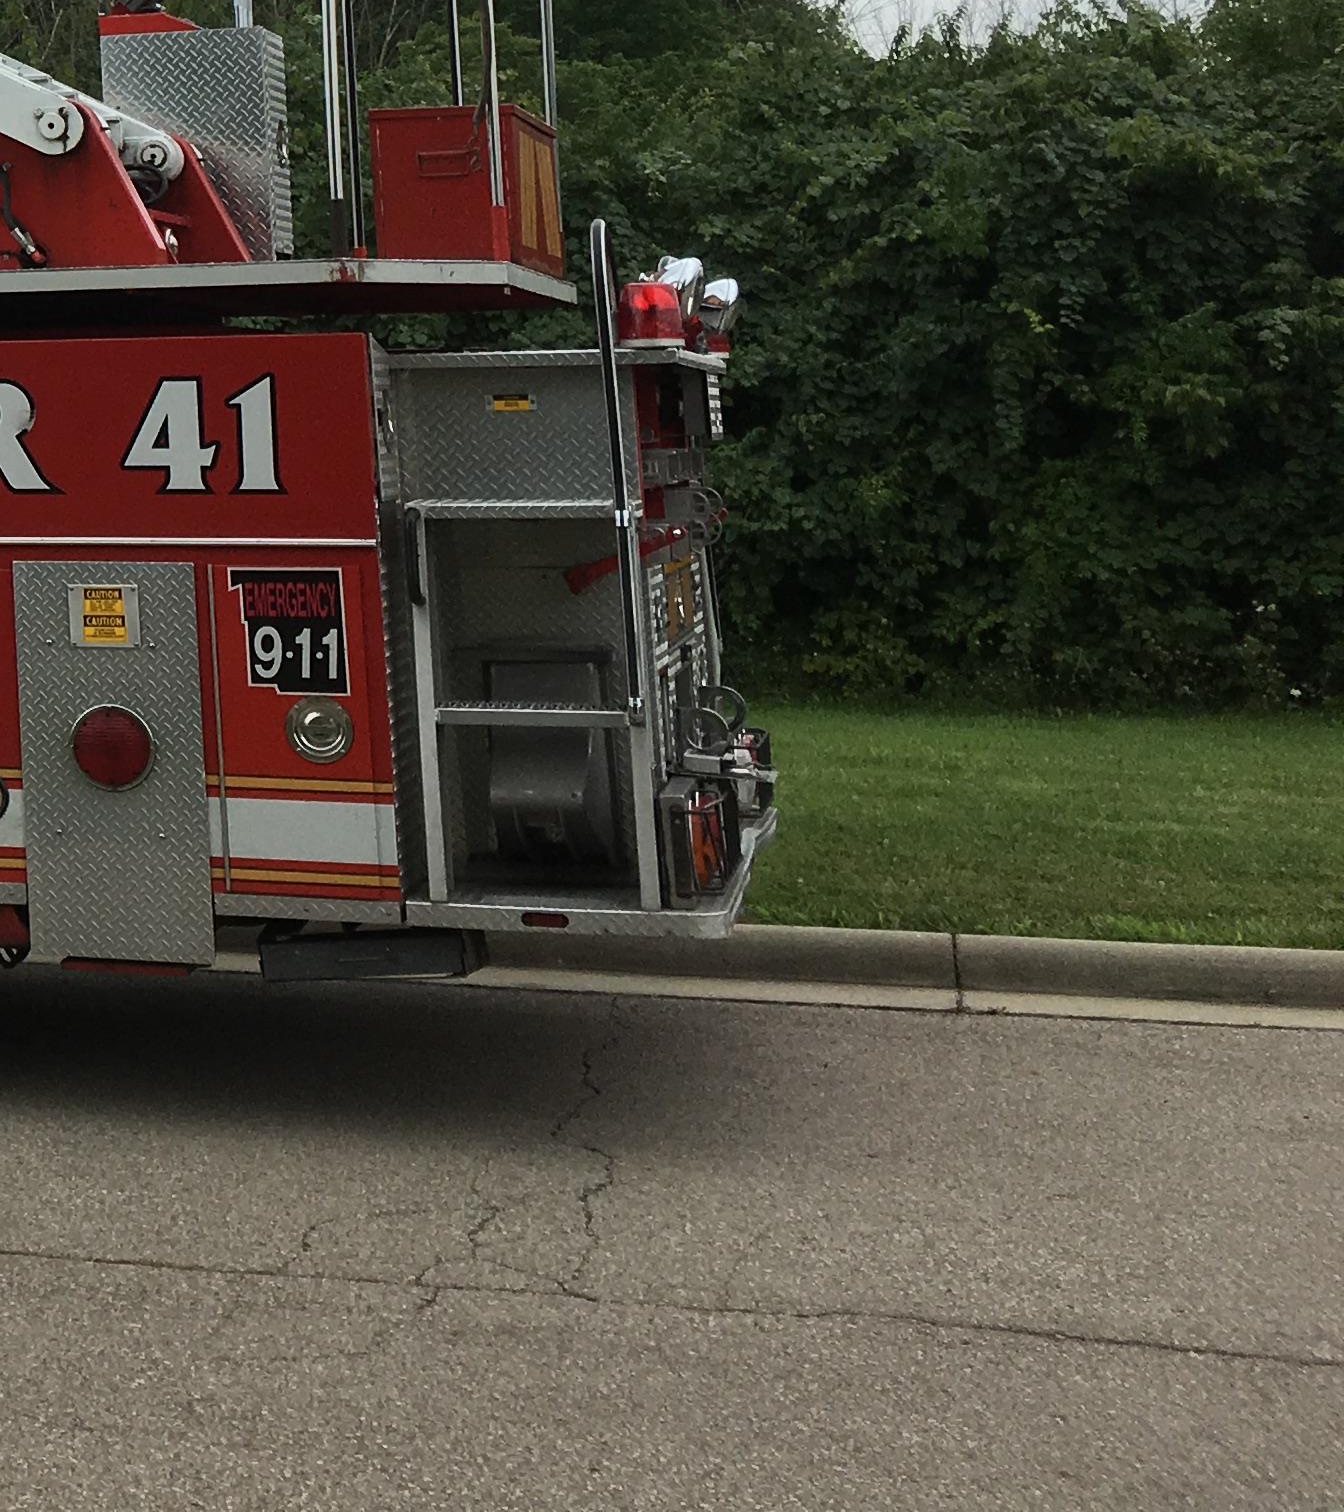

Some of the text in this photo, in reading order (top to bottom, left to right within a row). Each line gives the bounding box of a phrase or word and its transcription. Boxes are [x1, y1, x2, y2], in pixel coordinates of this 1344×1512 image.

[121, 373, 288, 495] 41
[86, 590, 119, 599] CAUTION
[244, 582, 336, 618] EMERGENCY
[86, 616, 123, 626] CAUTION
